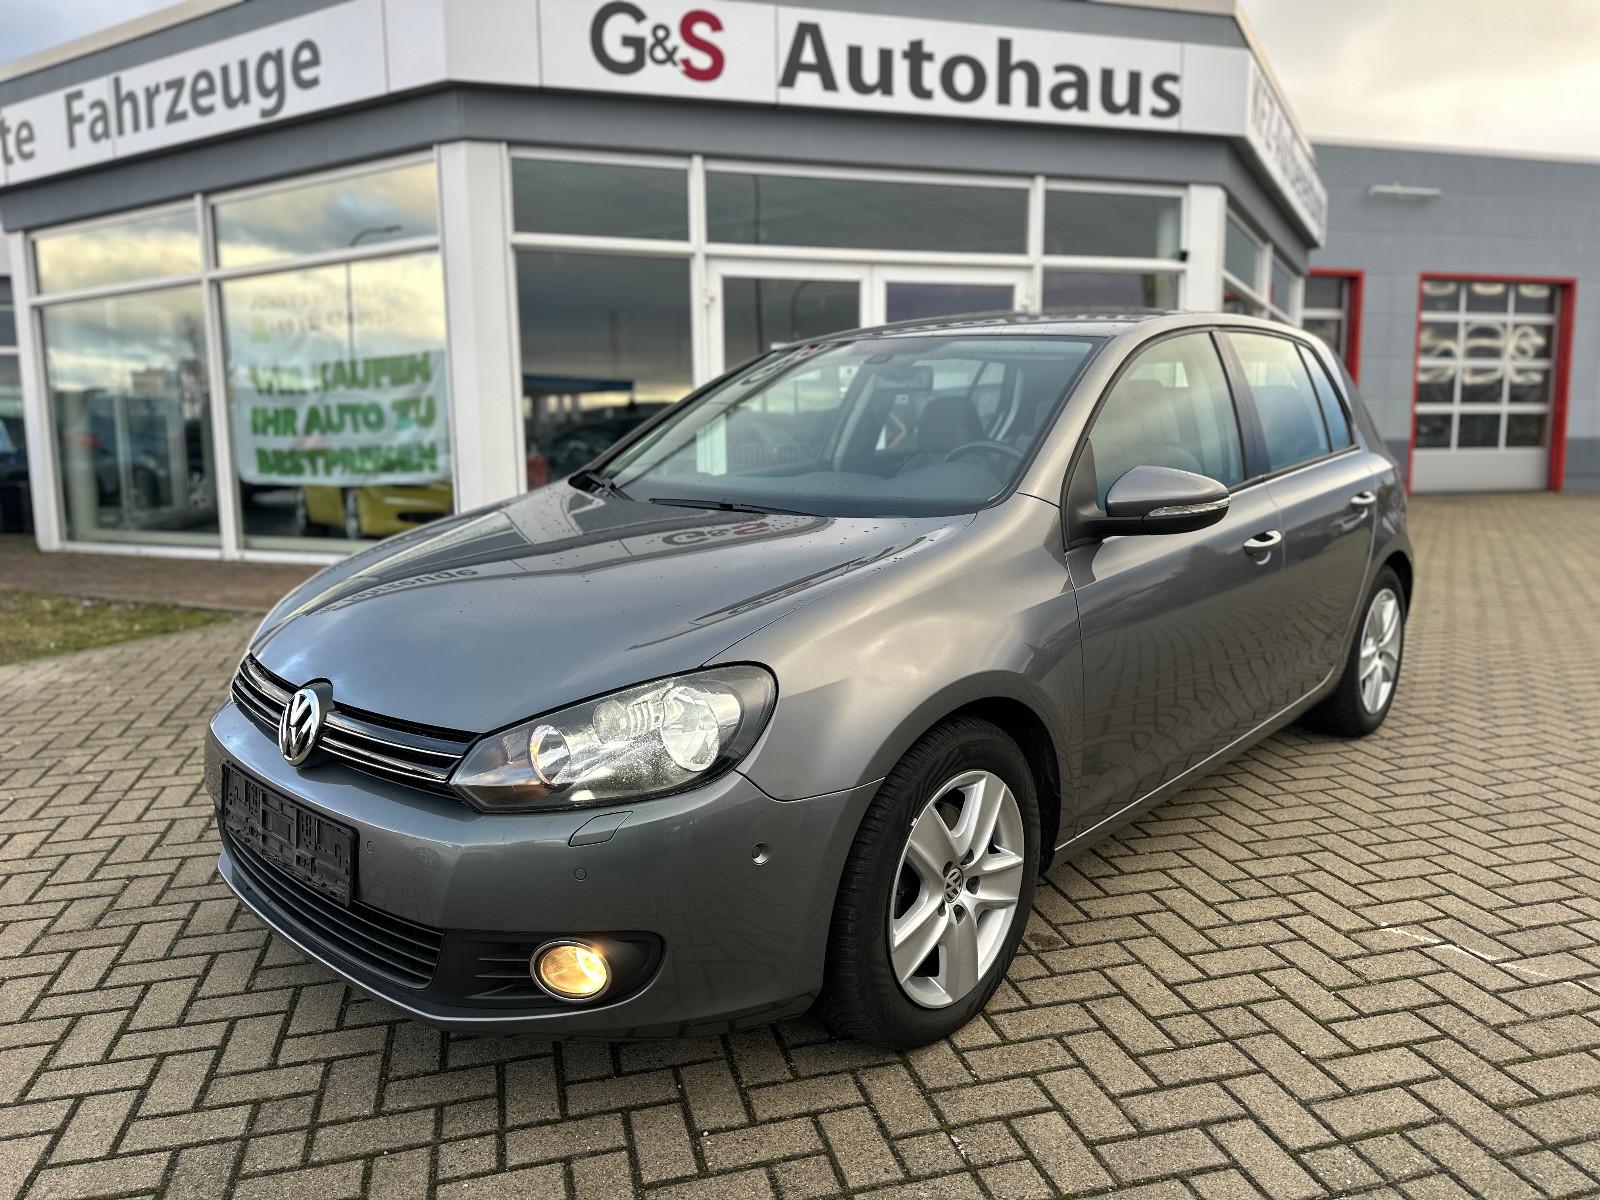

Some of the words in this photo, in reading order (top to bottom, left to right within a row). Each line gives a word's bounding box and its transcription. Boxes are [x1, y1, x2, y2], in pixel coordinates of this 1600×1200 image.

[64, 38, 322, 149] Fahrzeuge
[589, 1, 725, 82] G&S
[777, 21, 1182, 119] Autohaus
[251, 406, 298, 436] IHR
[303, 402, 386, 436] AUTO
